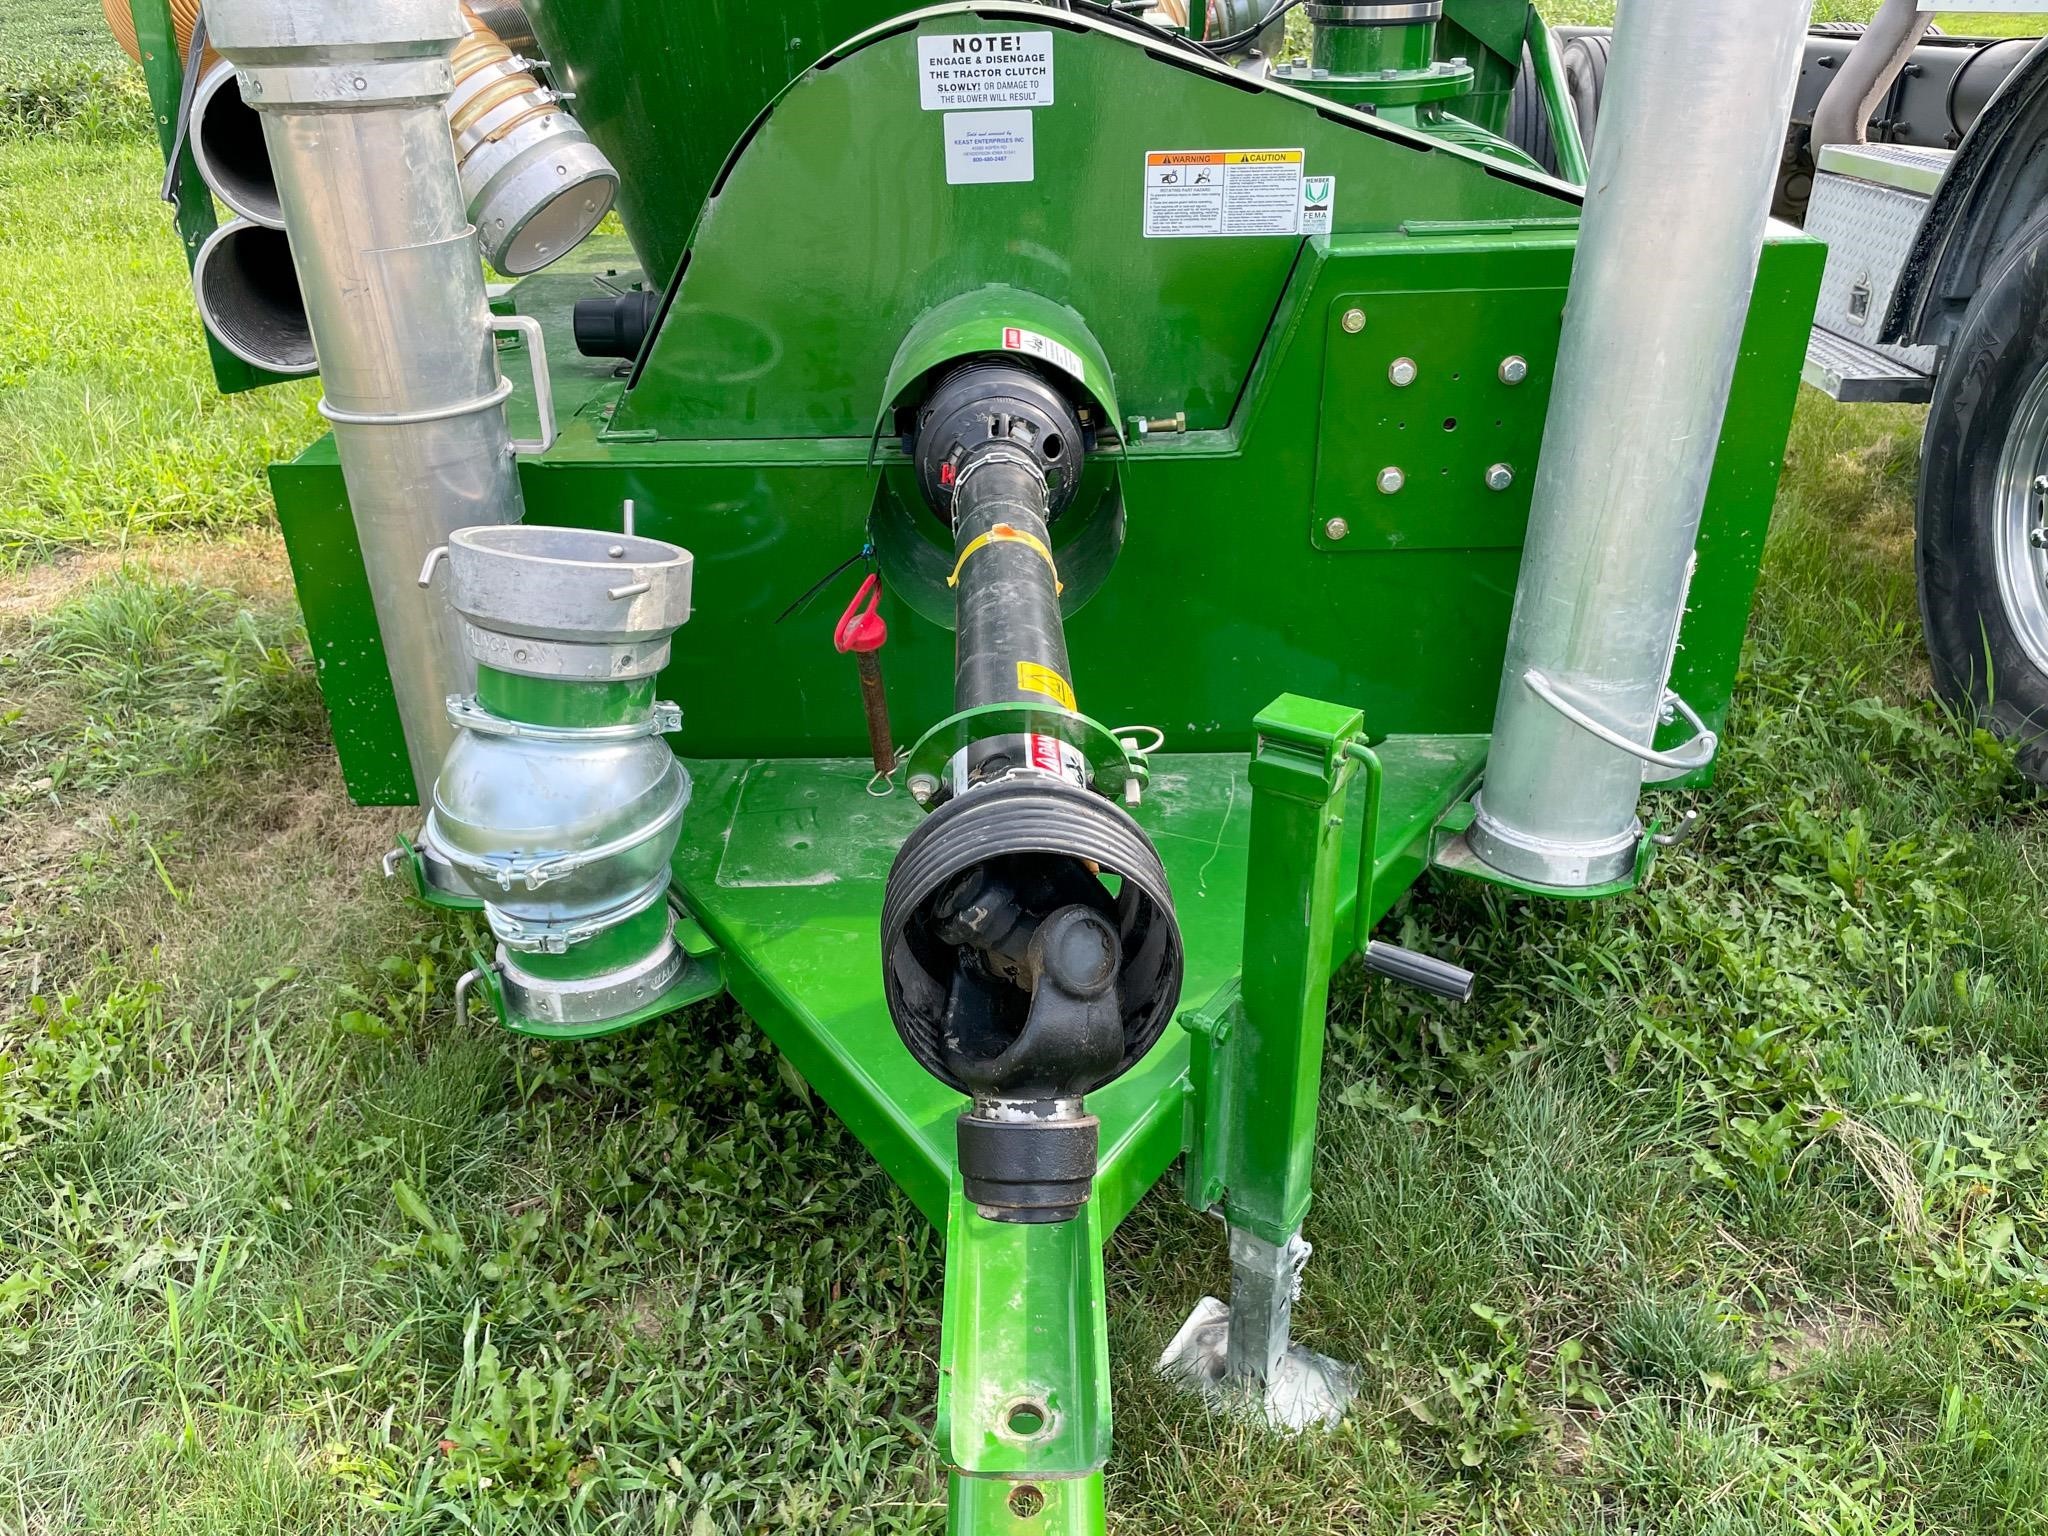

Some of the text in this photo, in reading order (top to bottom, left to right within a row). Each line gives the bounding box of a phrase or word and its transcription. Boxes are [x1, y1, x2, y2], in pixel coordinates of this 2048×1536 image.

[953, 36, 1021, 53] NOTE!
[929, 54, 1045, 66] ENGAGE & DISENGAGE
[929, 67, 1046, 79] THE TRACTOR CLUTCH
[937, 80, 1040, 92] SLOWLY! OR DAMAGE TO
[940, 92, 1037, 104] THE BLOWER WILL RESULT
[1172, 155, 1211, 163] WARNING
[1249, 153, 1287, 162] CAUTION
